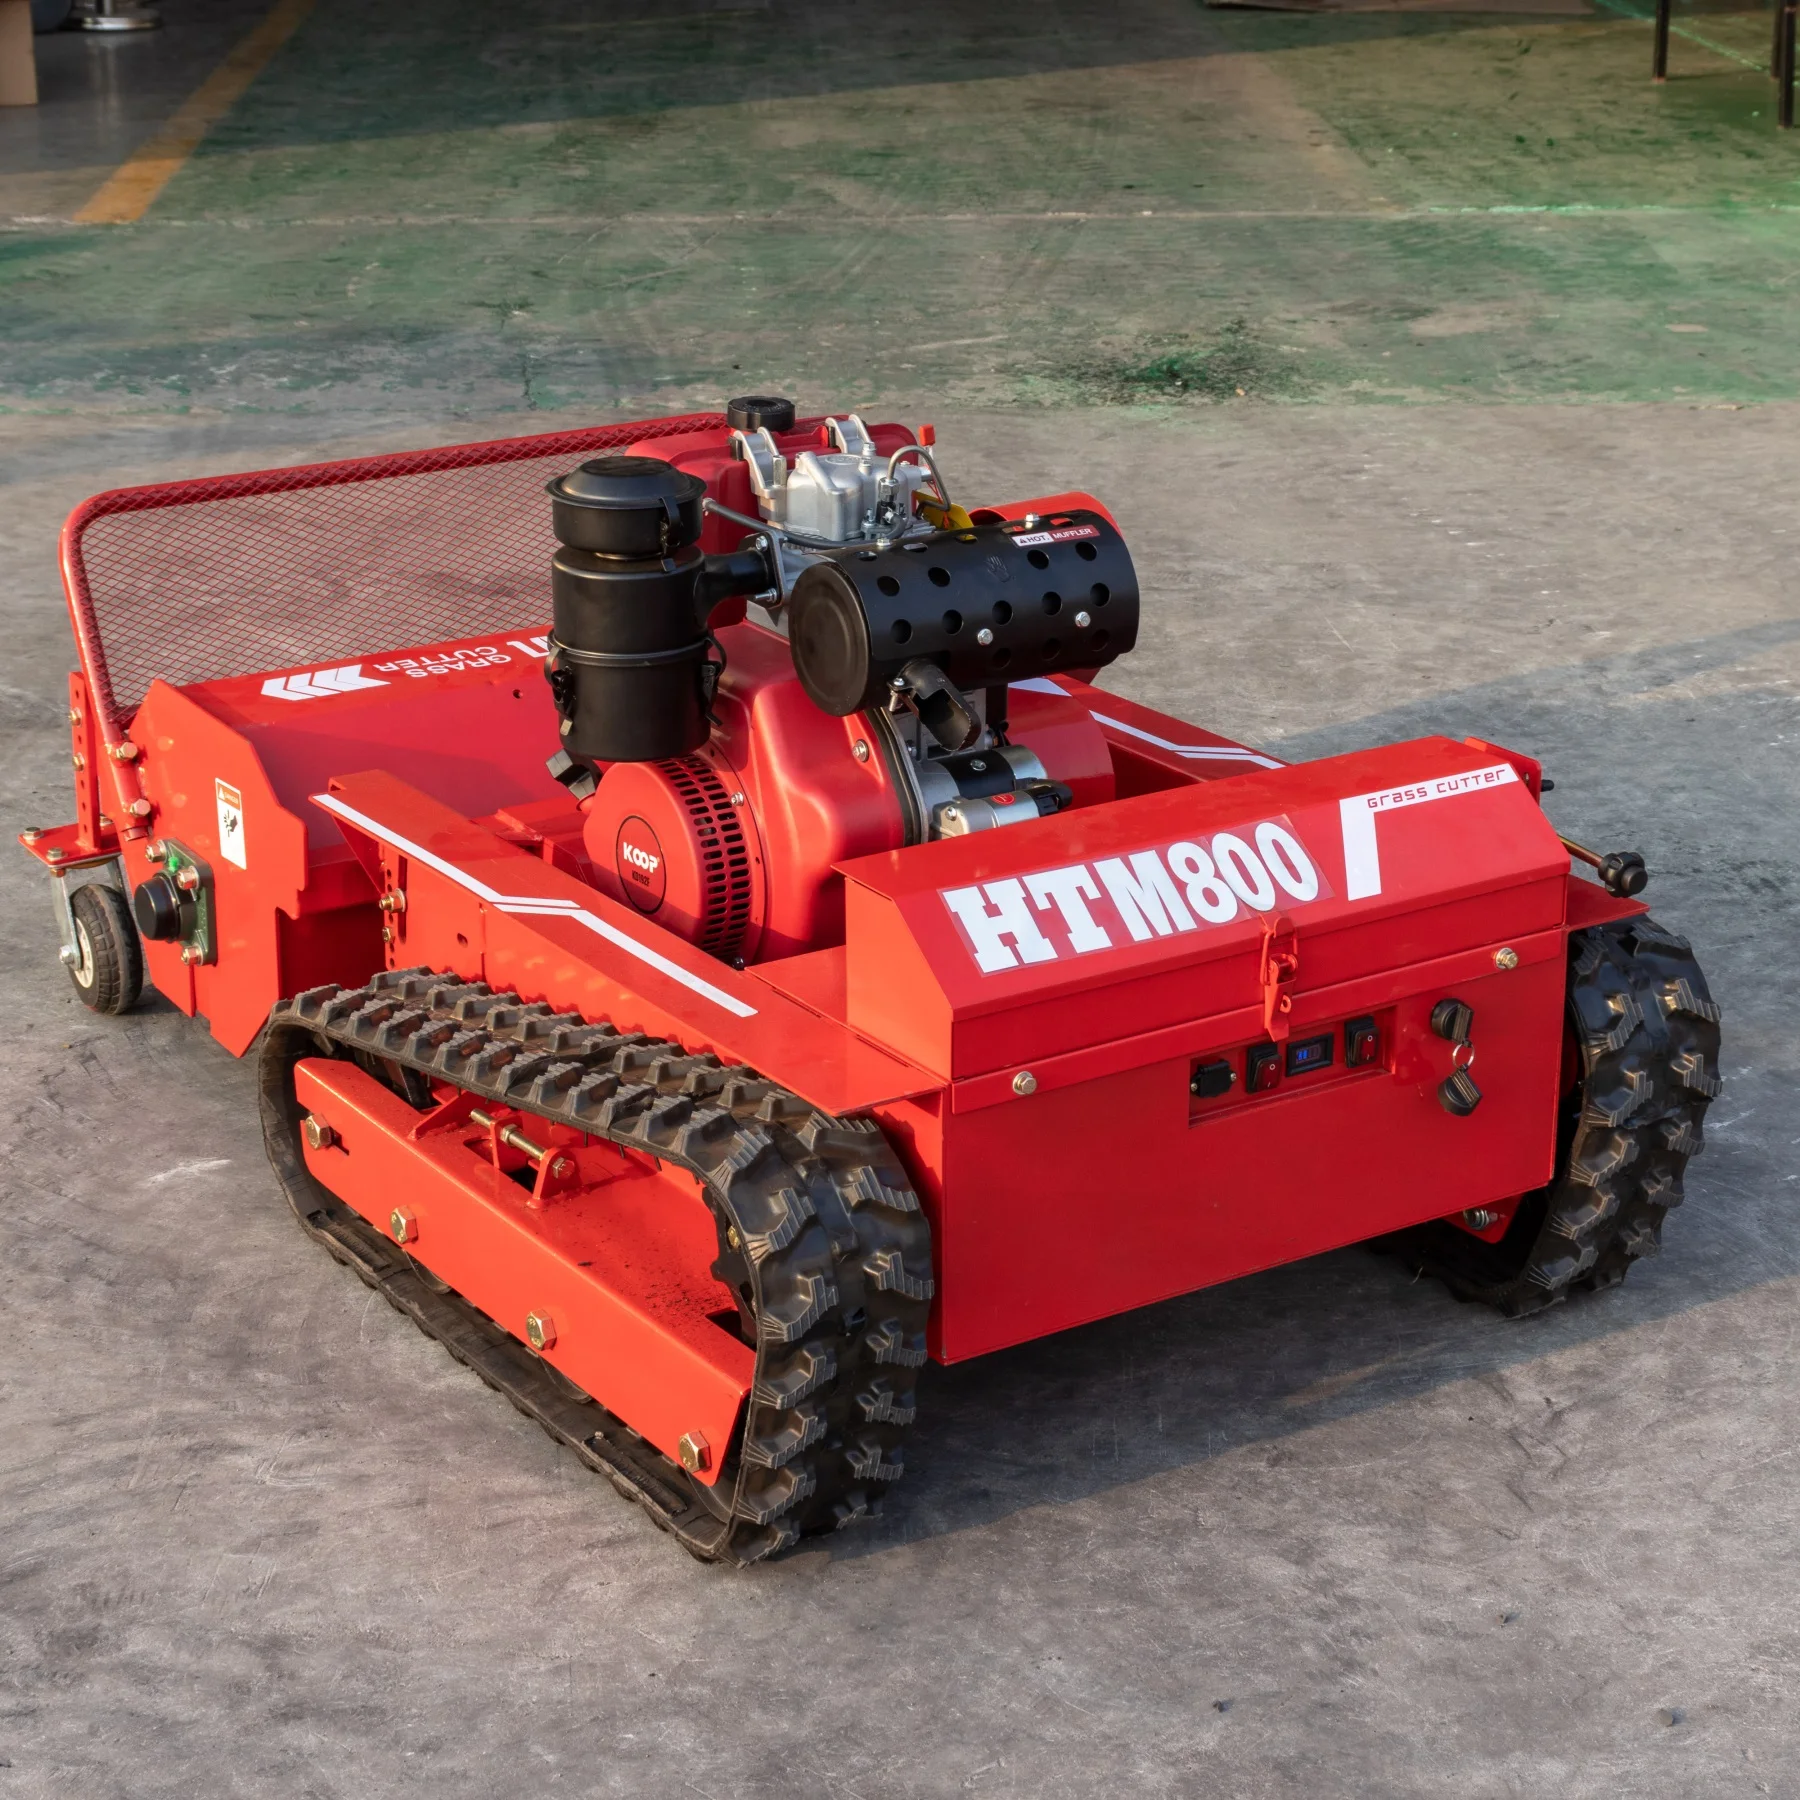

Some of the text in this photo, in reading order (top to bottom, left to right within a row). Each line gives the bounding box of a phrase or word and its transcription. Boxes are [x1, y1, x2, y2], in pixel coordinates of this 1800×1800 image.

[1053, 528, 1092, 539] MUFFLER
[373, 646, 498, 672] CUTTER
[405, 654, 512, 678] GRASS
[623, 842, 659, 872] KOOP
[944, 824, 1318, 972] HTM800
